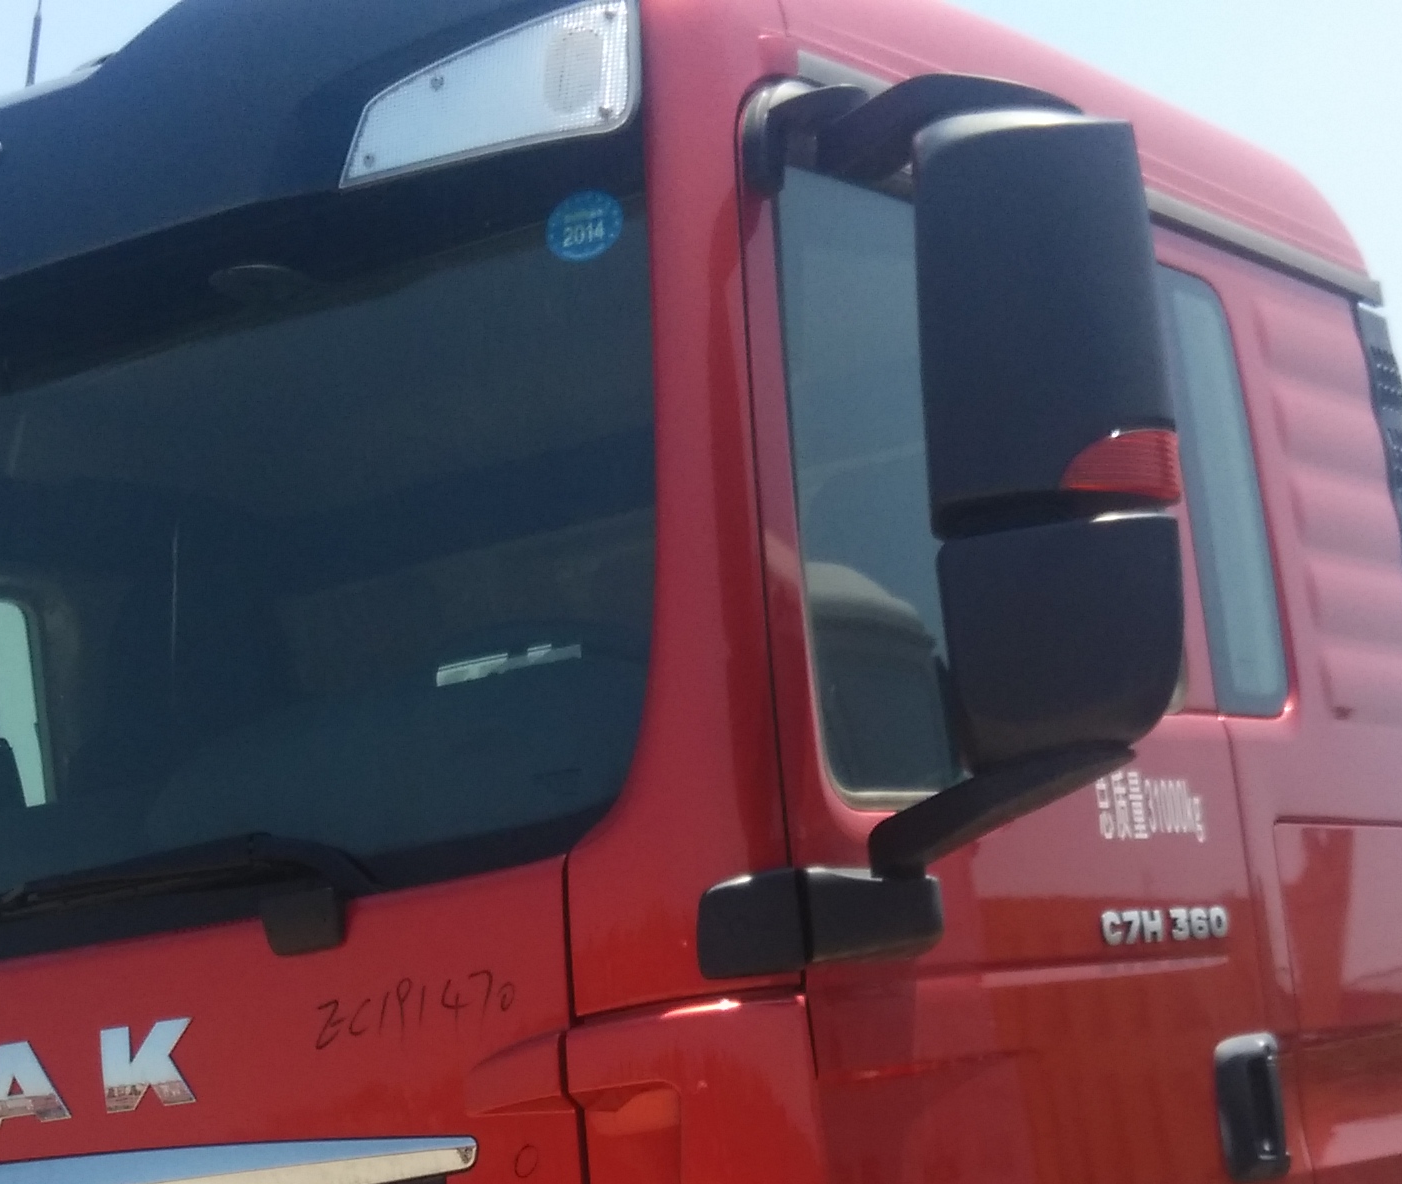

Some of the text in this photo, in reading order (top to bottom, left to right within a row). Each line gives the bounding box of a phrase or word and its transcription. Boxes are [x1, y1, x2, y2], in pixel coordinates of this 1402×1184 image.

[563, 219, 606, 248] 2014
[1101, 904, 1229, 946] C7H 360
